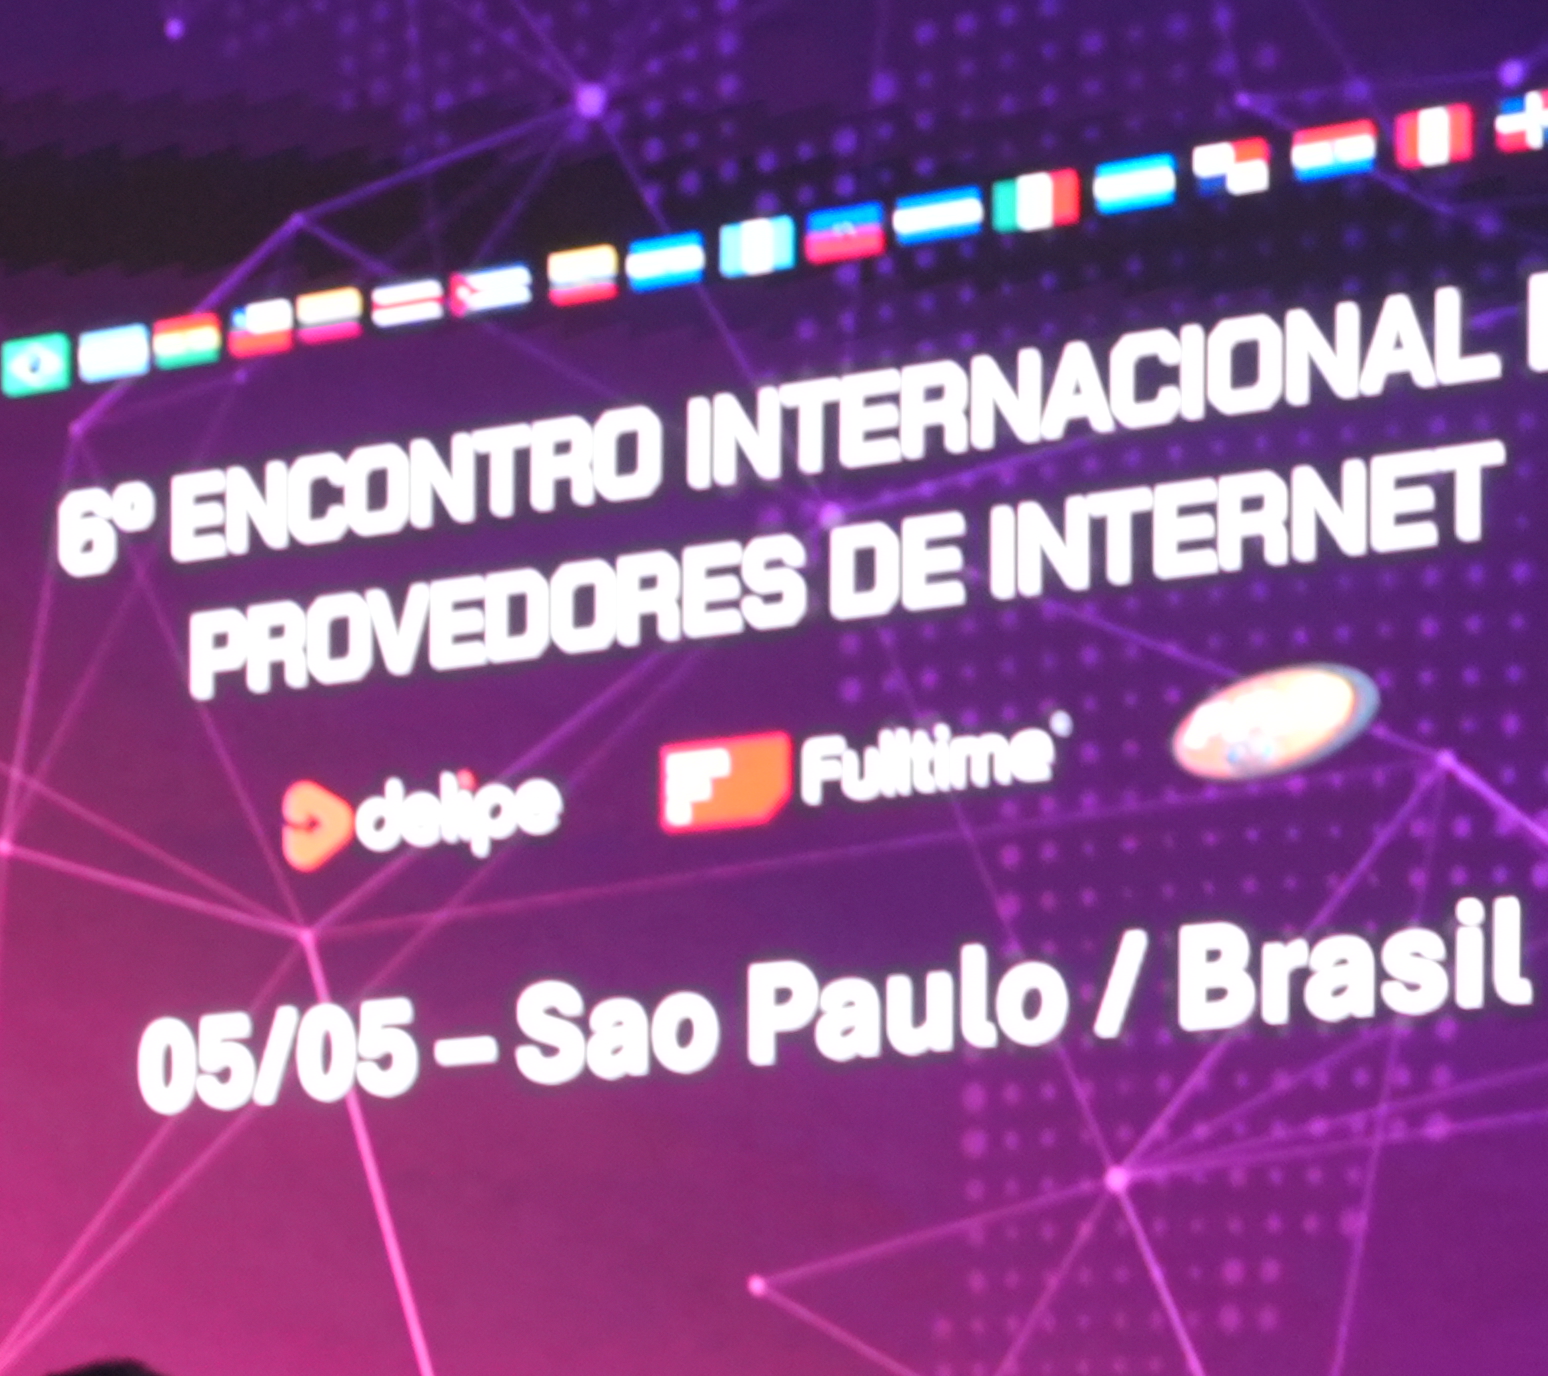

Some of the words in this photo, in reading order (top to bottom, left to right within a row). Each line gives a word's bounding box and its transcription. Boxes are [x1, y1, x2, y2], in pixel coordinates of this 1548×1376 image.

[56, 480, 157, 578] 6º
[169, 404, 664, 563] ENCONTRO
[686, 286, 1503, 490] INTERNACIONAL
[189, 533, 809, 701] PROVEDORES
[829, 510, 967, 621] DE
[989, 439, 1507, 601] INTERNET
[137, 996, 420, 1116] 05/05
[514, 979, 721, 1086] Sao
[746, 943, 1070, 1067] Paulo
[1177, 897, 1534, 1032] Brasil
